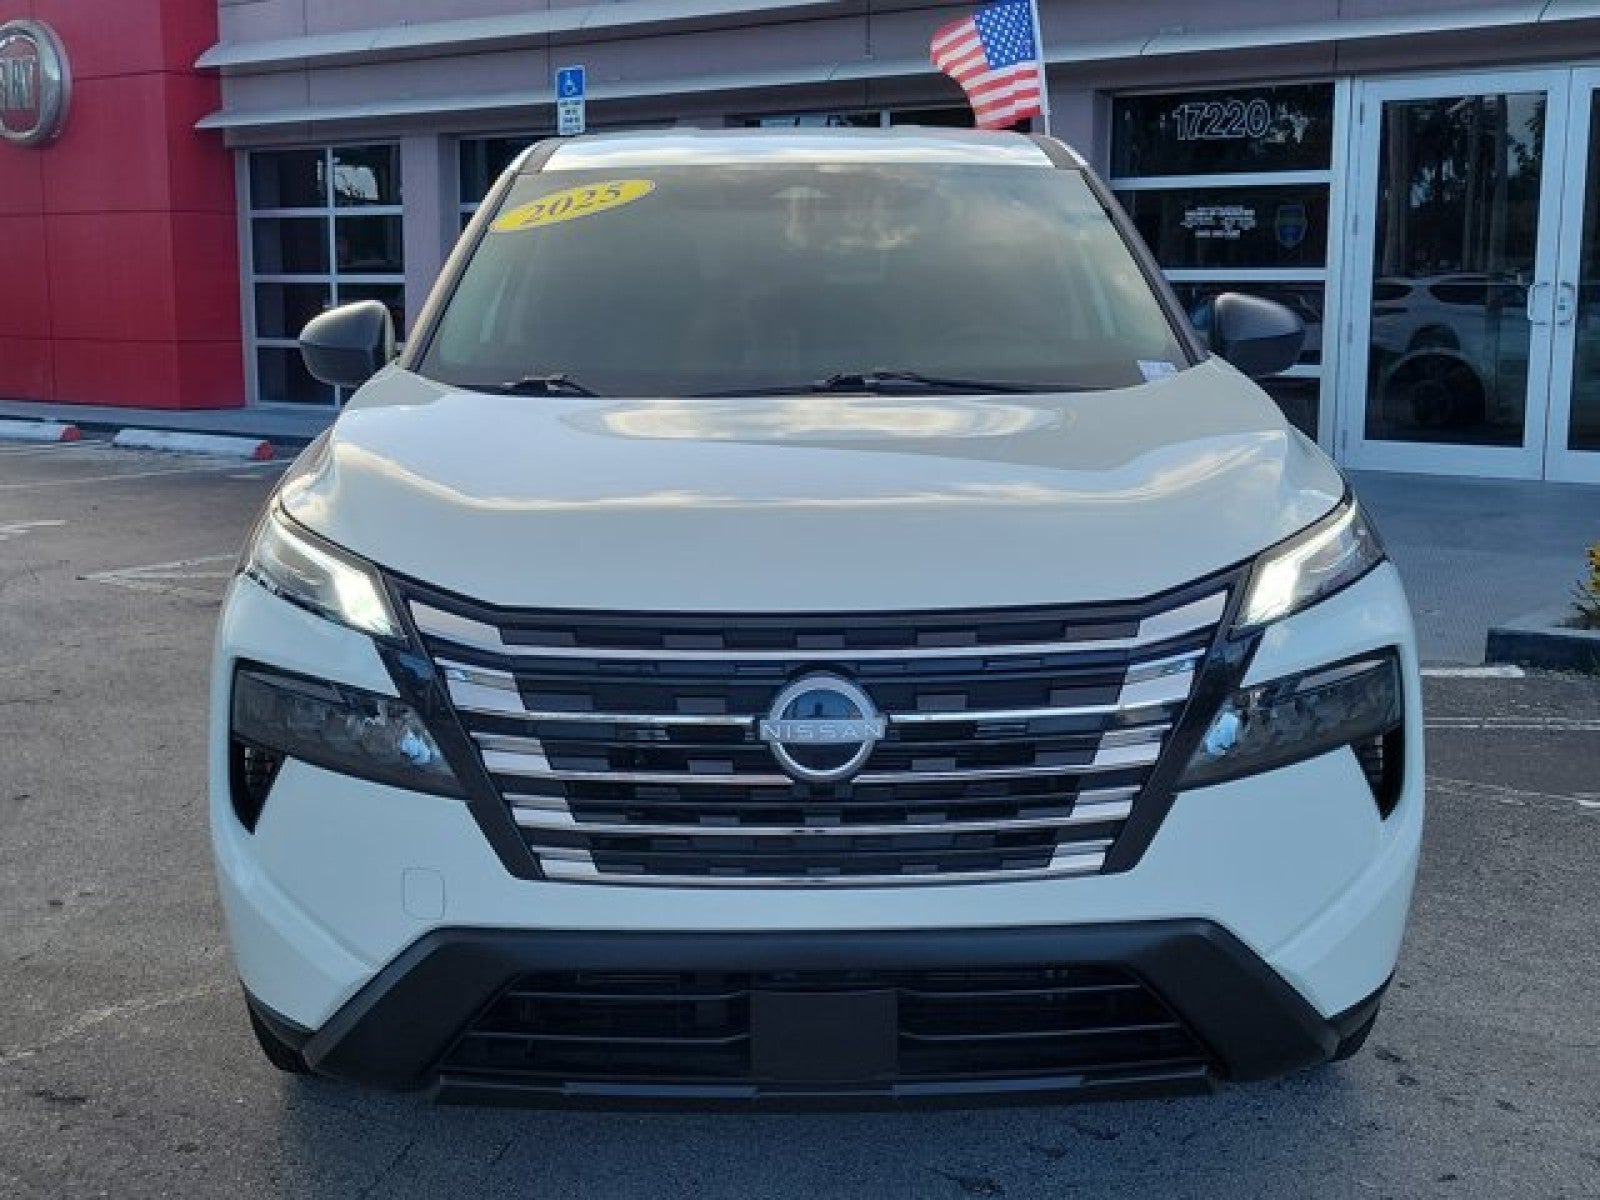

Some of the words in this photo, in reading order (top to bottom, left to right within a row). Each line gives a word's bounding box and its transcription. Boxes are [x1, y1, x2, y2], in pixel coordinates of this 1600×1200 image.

[1172, 99, 1271, 141] 17220
[519, 184, 623, 225] 2025
[761, 723, 882, 739] NISSAN
